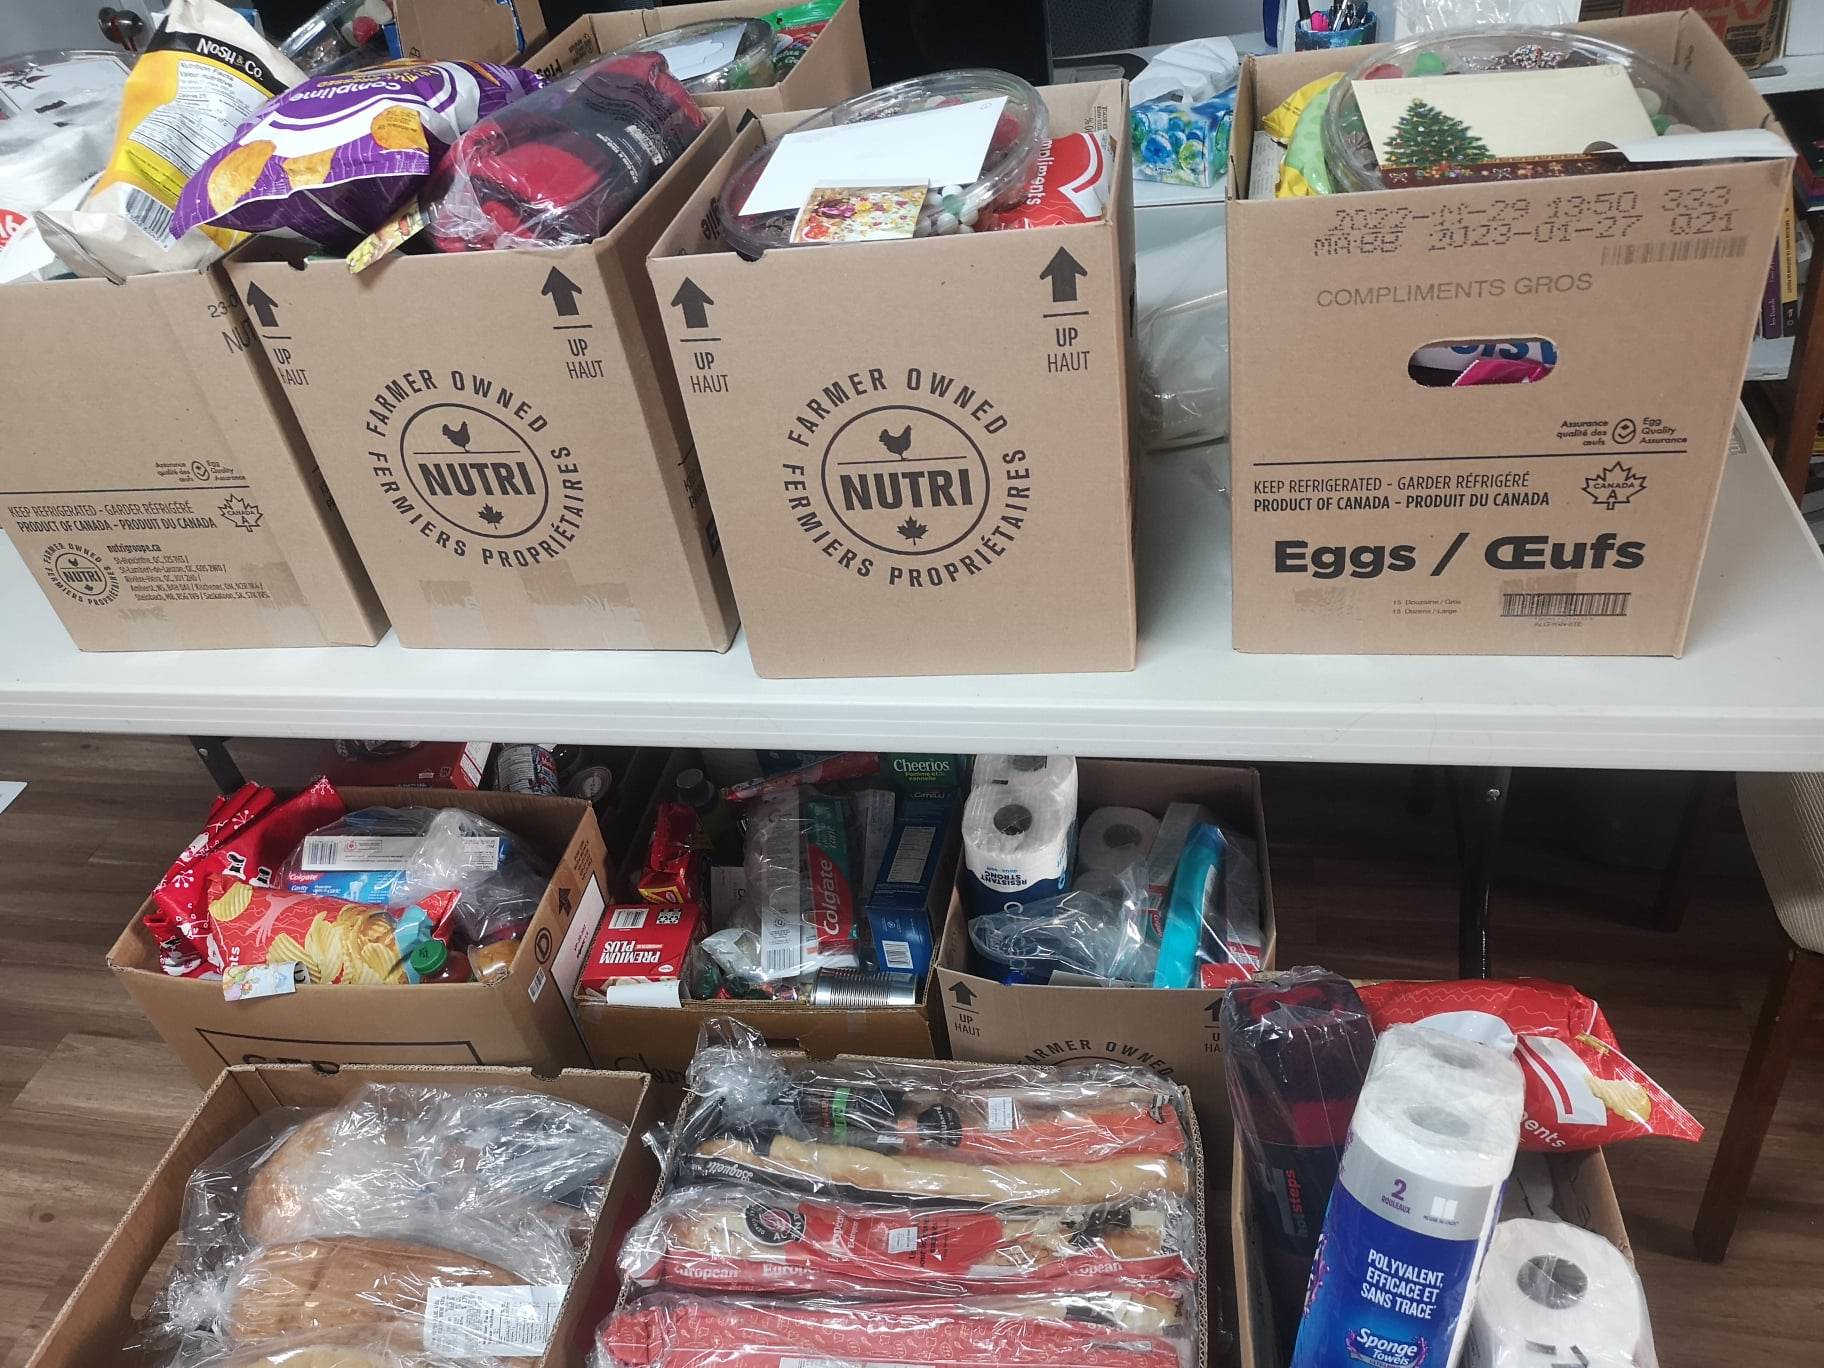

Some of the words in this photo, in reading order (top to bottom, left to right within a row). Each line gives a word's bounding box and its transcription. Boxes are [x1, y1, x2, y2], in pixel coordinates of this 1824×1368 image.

[1428, 215, 1643, 251] 2023-01-27
[1317, 278, 1510, 307] COMPLIMENTS
[1514, 273, 1593, 297] GROS
[1055, 327, 1078, 347] UP
[273, 348, 292, 365] UP
[568, 338, 589, 357] UP
[566, 360, 604, 379] HAUT
[694, 352, 715, 370] UP
[1047, 351, 1090, 373] HAUT
[690, 374, 728, 393] HAUT
[367, 369, 437, 437] FARMER
[451, 370, 548, 433] OWNED
[787, 368, 887, 447] FARMER
[907, 368, 1008, 434] OWNED
[1556, 429, 1588, 438] qualité
[1590, 428, 1607, 436] des
[1641, 426, 1676, 435] Quality
[1560, 420, 1609, 428] Assurance
[1643, 417, 1662, 426] Egg
[1640, 436, 1688, 444] Assurance
[418, 462, 536, 496] NUTRI
[1254, 480, 1285, 494] KEEP
[1289, 477, 1382, 493] REFRIGERATED
[1397, 475, 1451, 490] GARDER
[1456, 471, 1529, 488] RÉFRIGÉRÉ
[1594, 482, 1635, 490] CANADA
[840, 468, 973, 510] NUTRI
[1607, 489, 1618, 500] A
[8, 506, 31, 518] KEEP
[32, 504, 97, 517] REFRIGERATED
[104, 503, 143, 516] GARDER
[144, 500, 194, 514] RÉFRIGÉRÉ
[368, 451, 467, 557] FERMIERS
[482, 446, 585, 568] PROPRIÉTAIRES
[1254, 497, 1312, 512] PRODUCT
[1316, 497, 1333, 511] OF
[1337, 496, 1390, 510] CANADA
[1406, 494, 1464, 508] PRODUIT
[1469, 493, 1488, 507] DU
[1493, 491, 1550, 506] CANADA
[17, 521, 60, 532] PRODUCT
[60, 520, 72, 531] OF
[74, 519, 113, 531] CANADA
[120, 518, 162, 530] PRODUIT
[163, 517, 176, 529] DU
[178, 516, 217, 529] CANADA
[783, 463, 874, 577] FERMIERS
[889, 450, 1031, 587] PROPRIÉTAIRES
[43, 542, 66, 564] FARMER
[1275, 539, 1417, 579] Eggs
[1430, 532, 1470, 576] /
[1485, 532, 1646, 571] Œufs
[63, 570, 102, 582] NUTRI
[893, 758, 951, 772] Cheerios
[984, 870, 1022, 880] STRONG
[819, 859, 840, 936] Colgate
[603, 940, 636, 953] PLUS
[599, 951, 660, 964] PREMIUM
[959, 1012, 973, 1025] UP
[954, 1022, 981, 1038] HAUT
[1106, 1041, 1174, 1077] OWNED
[1391, 1178, 1407, 1201] 2
[1381, 1195, 1411, 1214] ROULEAUX
[1368, 1248, 1444, 1288] POLYVALENT,
[1366, 1266, 1420, 1300] EFFICACE
[1423, 1287, 1439, 1303] ET
[1360, 1283, 1393, 1309] SANS
[1356, 1327, 1418, 1358] Sponge
[1372, 1349, 1410, 1365] Towels
